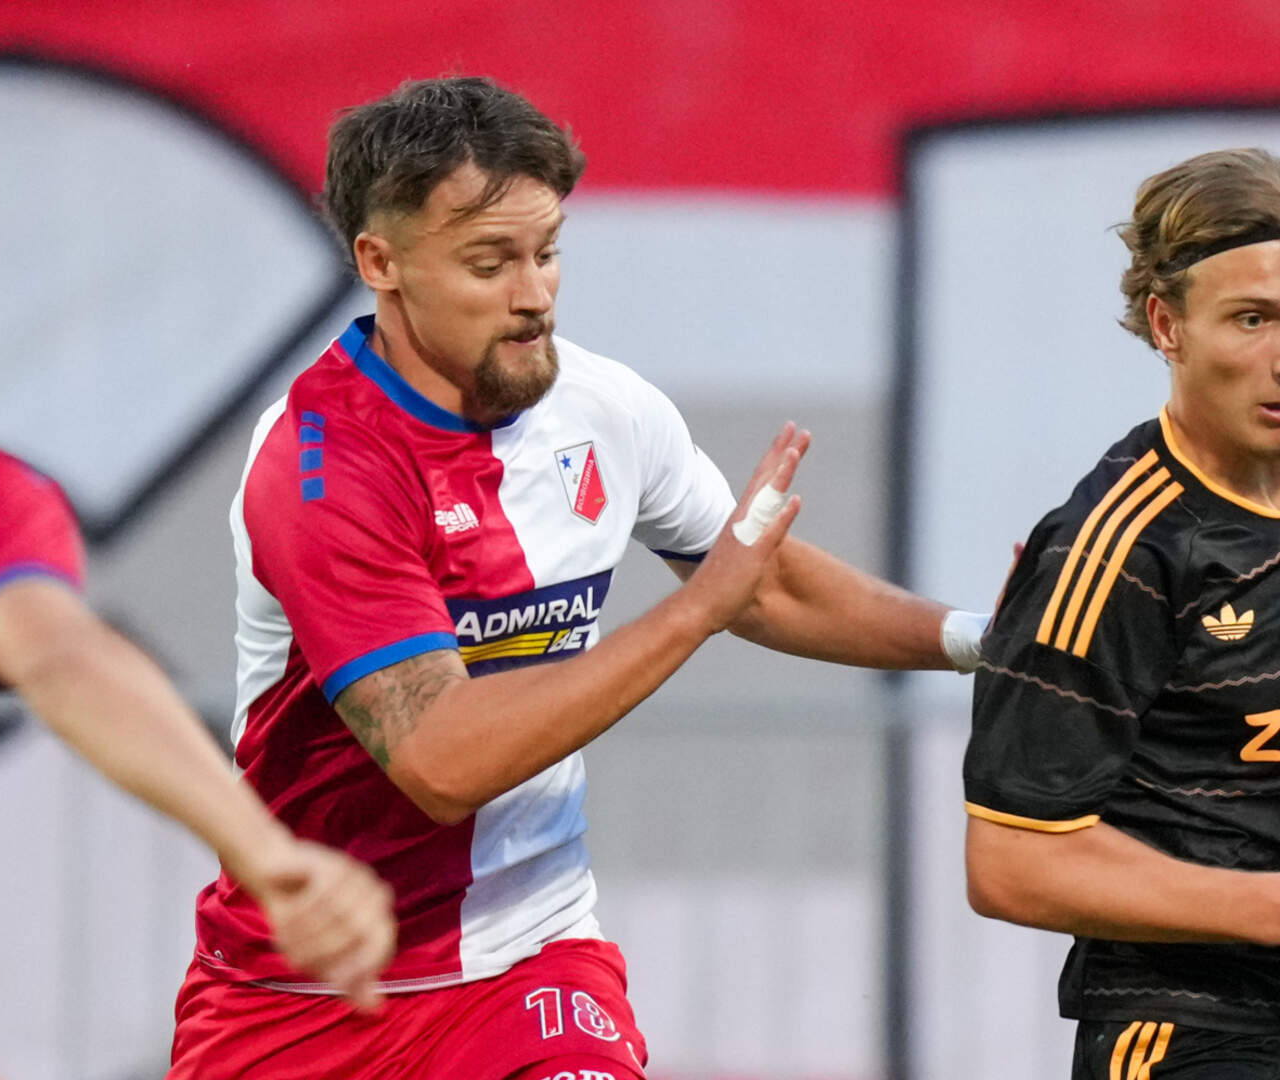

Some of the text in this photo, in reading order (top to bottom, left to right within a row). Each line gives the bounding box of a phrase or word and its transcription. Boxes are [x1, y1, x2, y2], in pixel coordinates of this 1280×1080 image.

[455, 586, 600, 642] ADMIRAL
[547, 621, 600, 653] BET
[525, 986, 621, 1042] 18
